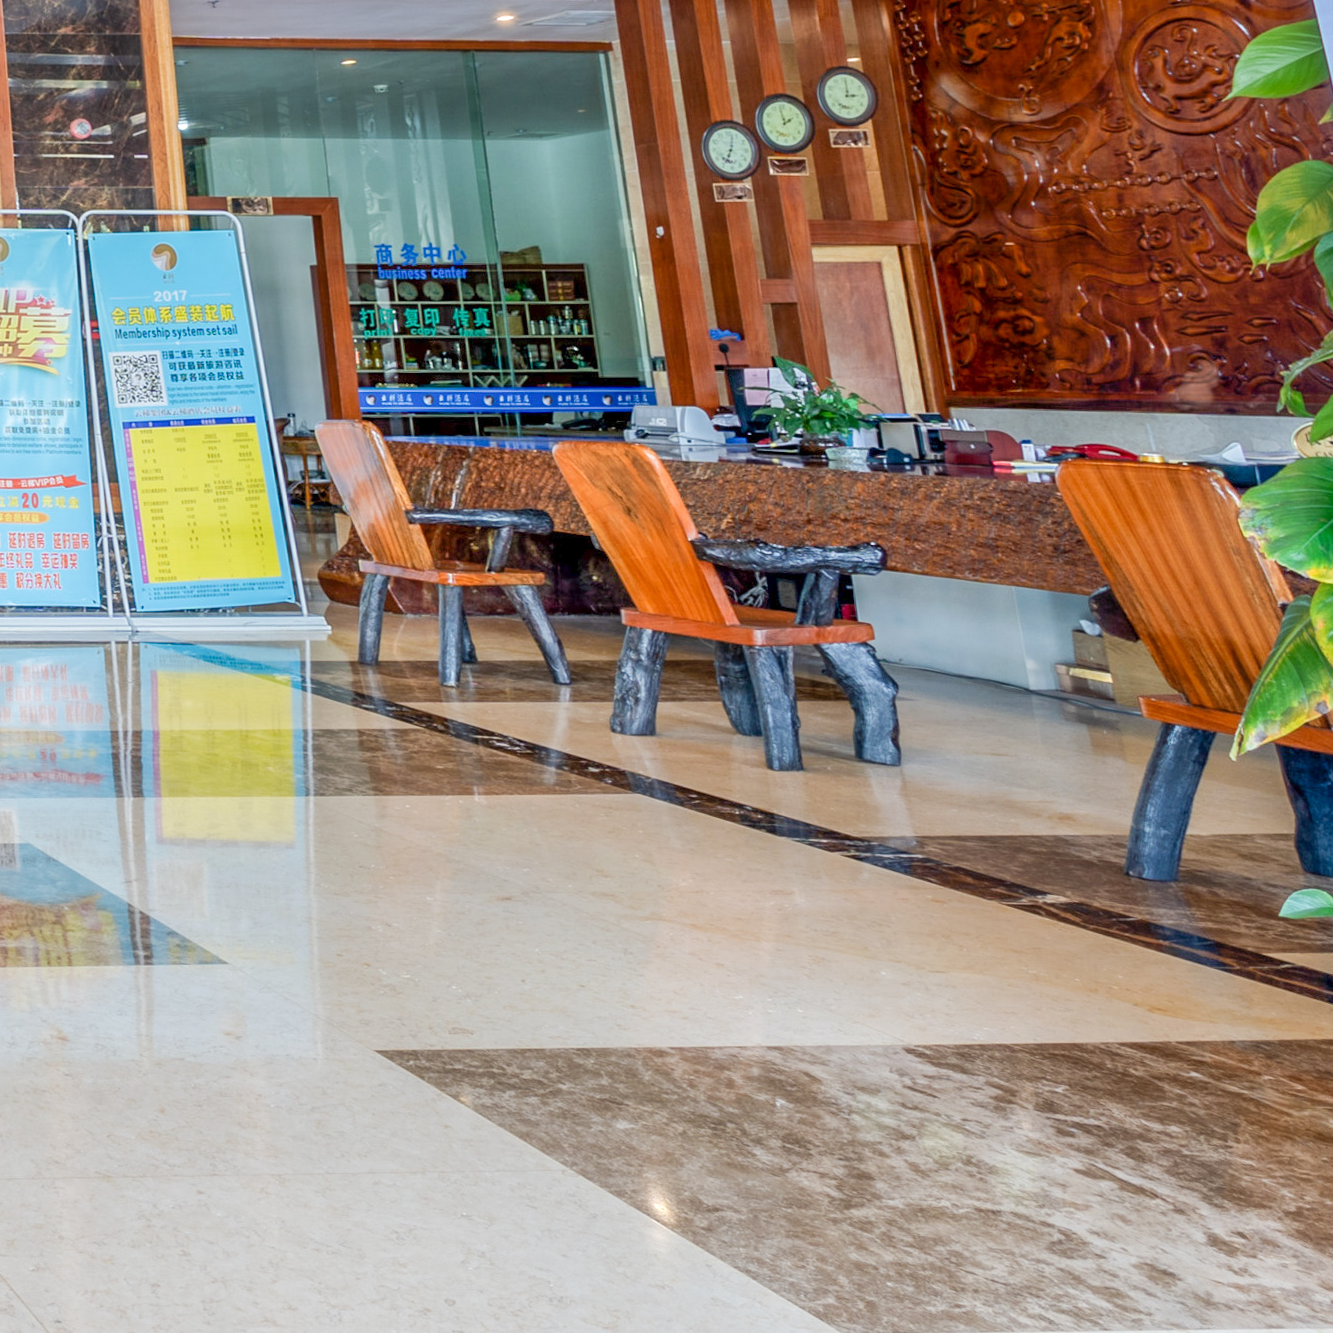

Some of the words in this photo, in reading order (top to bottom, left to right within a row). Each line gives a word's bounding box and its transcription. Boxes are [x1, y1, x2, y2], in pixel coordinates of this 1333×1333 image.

[374, 242, 467, 267] 商务中心
[377, 266, 427, 280] business
[431, 266, 468, 279] center
[153, 290, 188, 302] 2017
[111, 303, 235, 326] 会员体系盛装起航
[359, 308, 394, 327] 打印
[403, 308, 440, 327] 复印
[453, 307, 491, 327] 传真
[114, 326, 171, 340] Membership
[171, 326, 206, 338] system
[206, 325, 220, 336] set
[222, 324, 239, 335] sail
[363, 327, 392, 340] print
[410, 328, 437, 337] copy
[8, 532, 45, 549] 延时退房
[53, 533, 90, 549] 延时留房
[41, 553, 78, 569] 幸运抽奖
[16, 572, 62, 589] 积分换大礼
